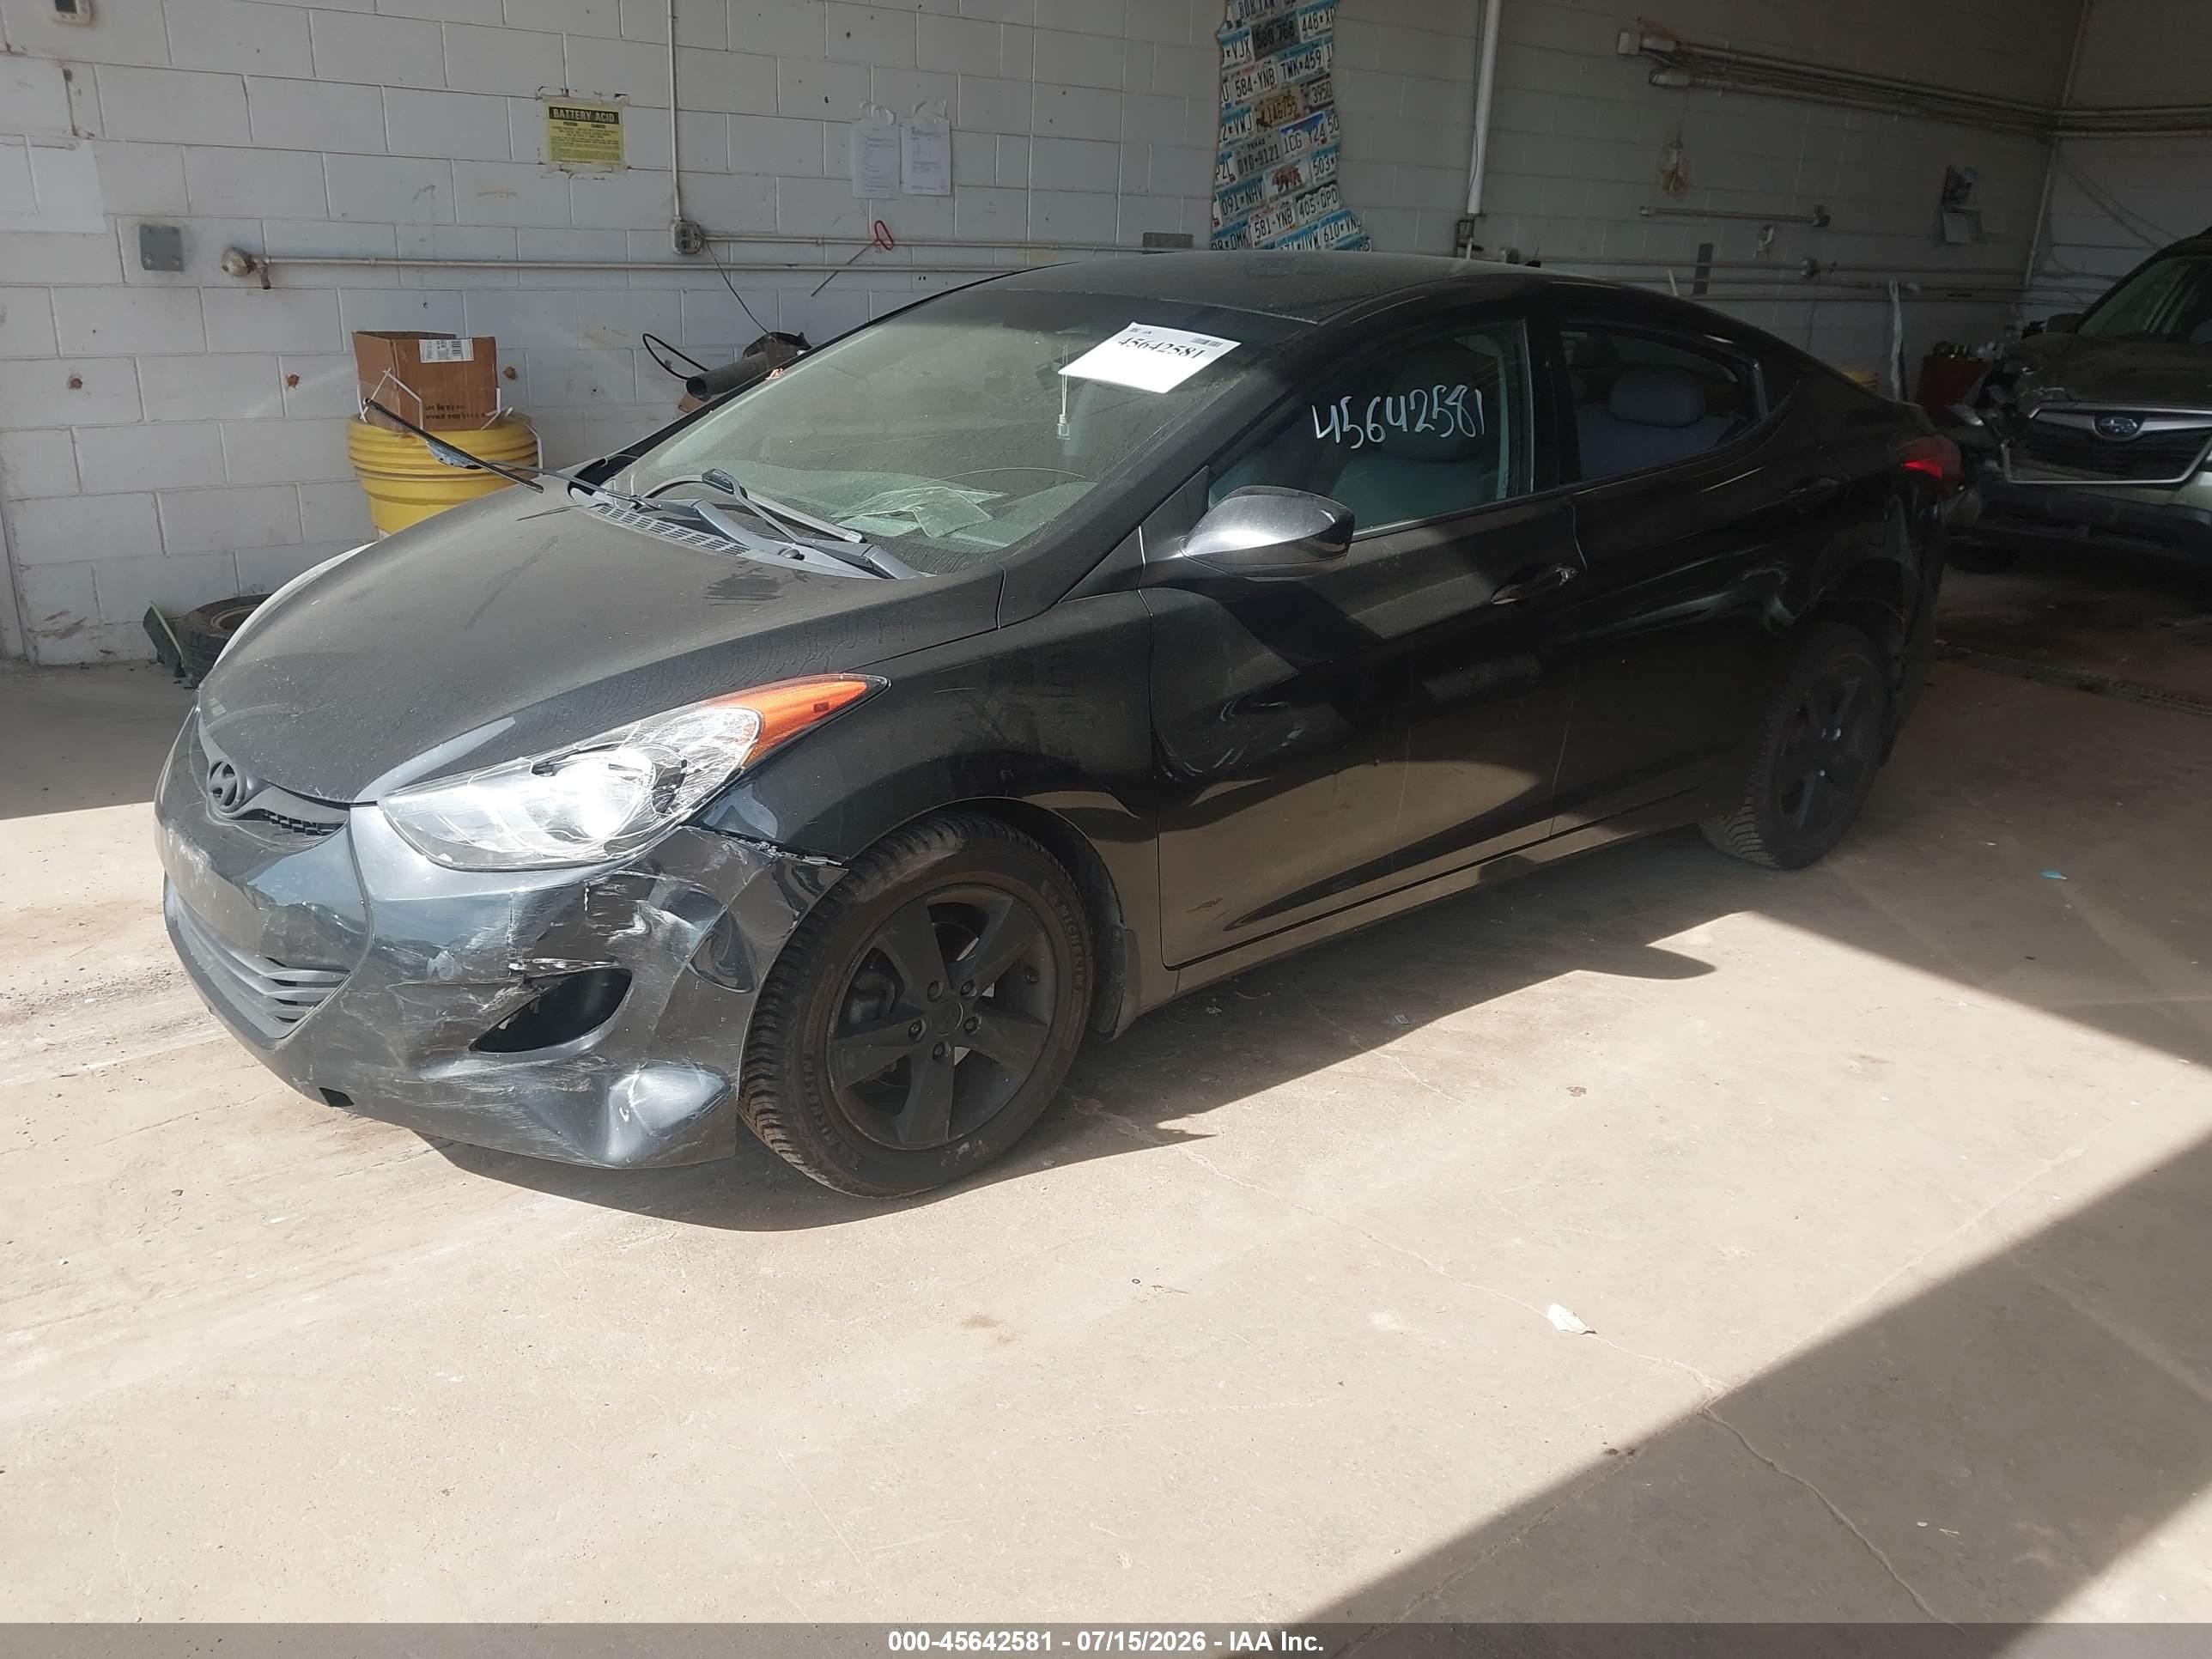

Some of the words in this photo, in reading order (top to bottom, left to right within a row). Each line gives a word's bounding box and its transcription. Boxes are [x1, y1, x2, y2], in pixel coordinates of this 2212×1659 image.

[553, 108, 592, 121] BATTERY
[595, 112, 615, 123] ACID
[1118, 337, 1206, 359] 45642581
[1311, 384, 1486, 449] 45642581
